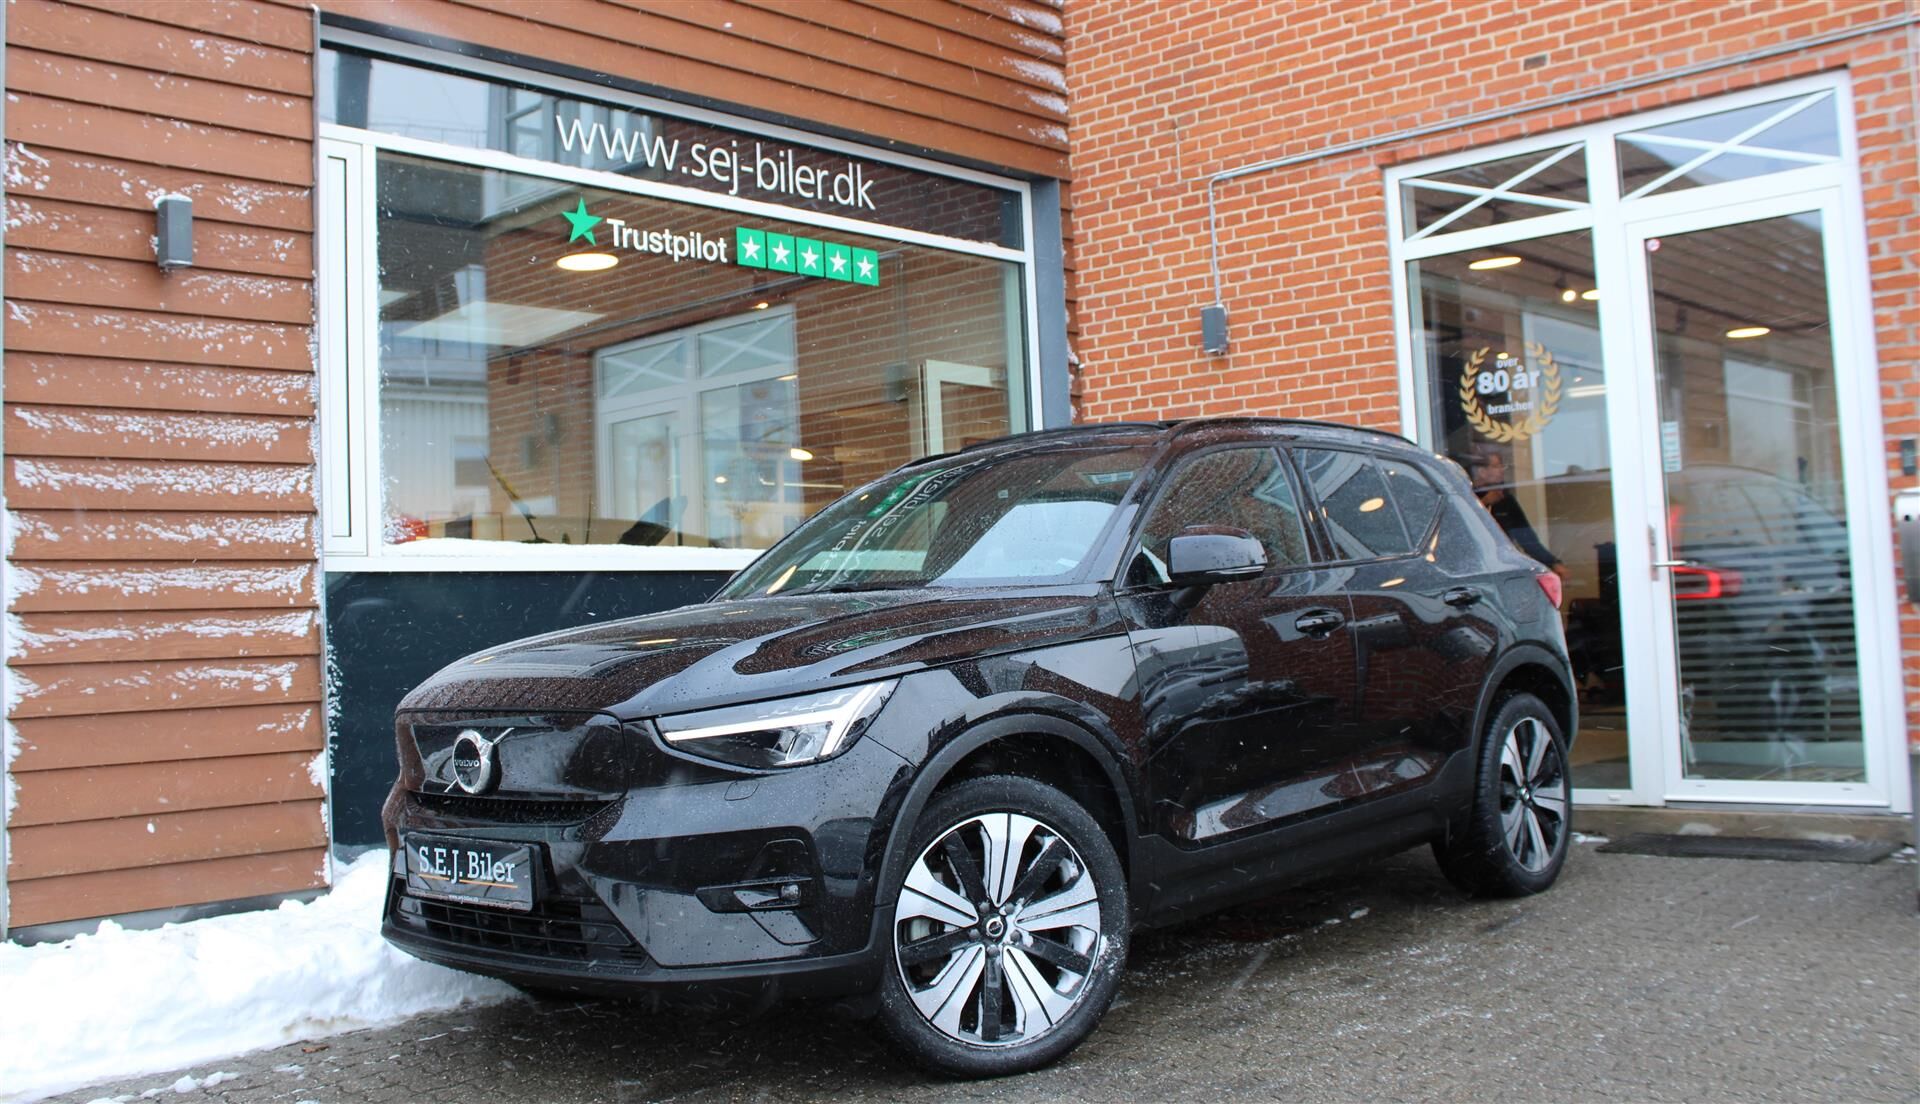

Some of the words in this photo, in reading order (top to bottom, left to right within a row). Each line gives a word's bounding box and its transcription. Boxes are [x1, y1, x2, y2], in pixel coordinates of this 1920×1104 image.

[556, 115, 876, 210] www.sej-biler.dk
[606, 217, 728, 263] Trustpilot
[1477, 369, 1510, 394] 80
[1513, 365, 1540, 389] år
[1497, 358, 1519, 368] over
[454, 759, 480, 767] VOLVO
[419, 847, 463, 884] S.E.J.
[467, 850, 515, 882] Biler
